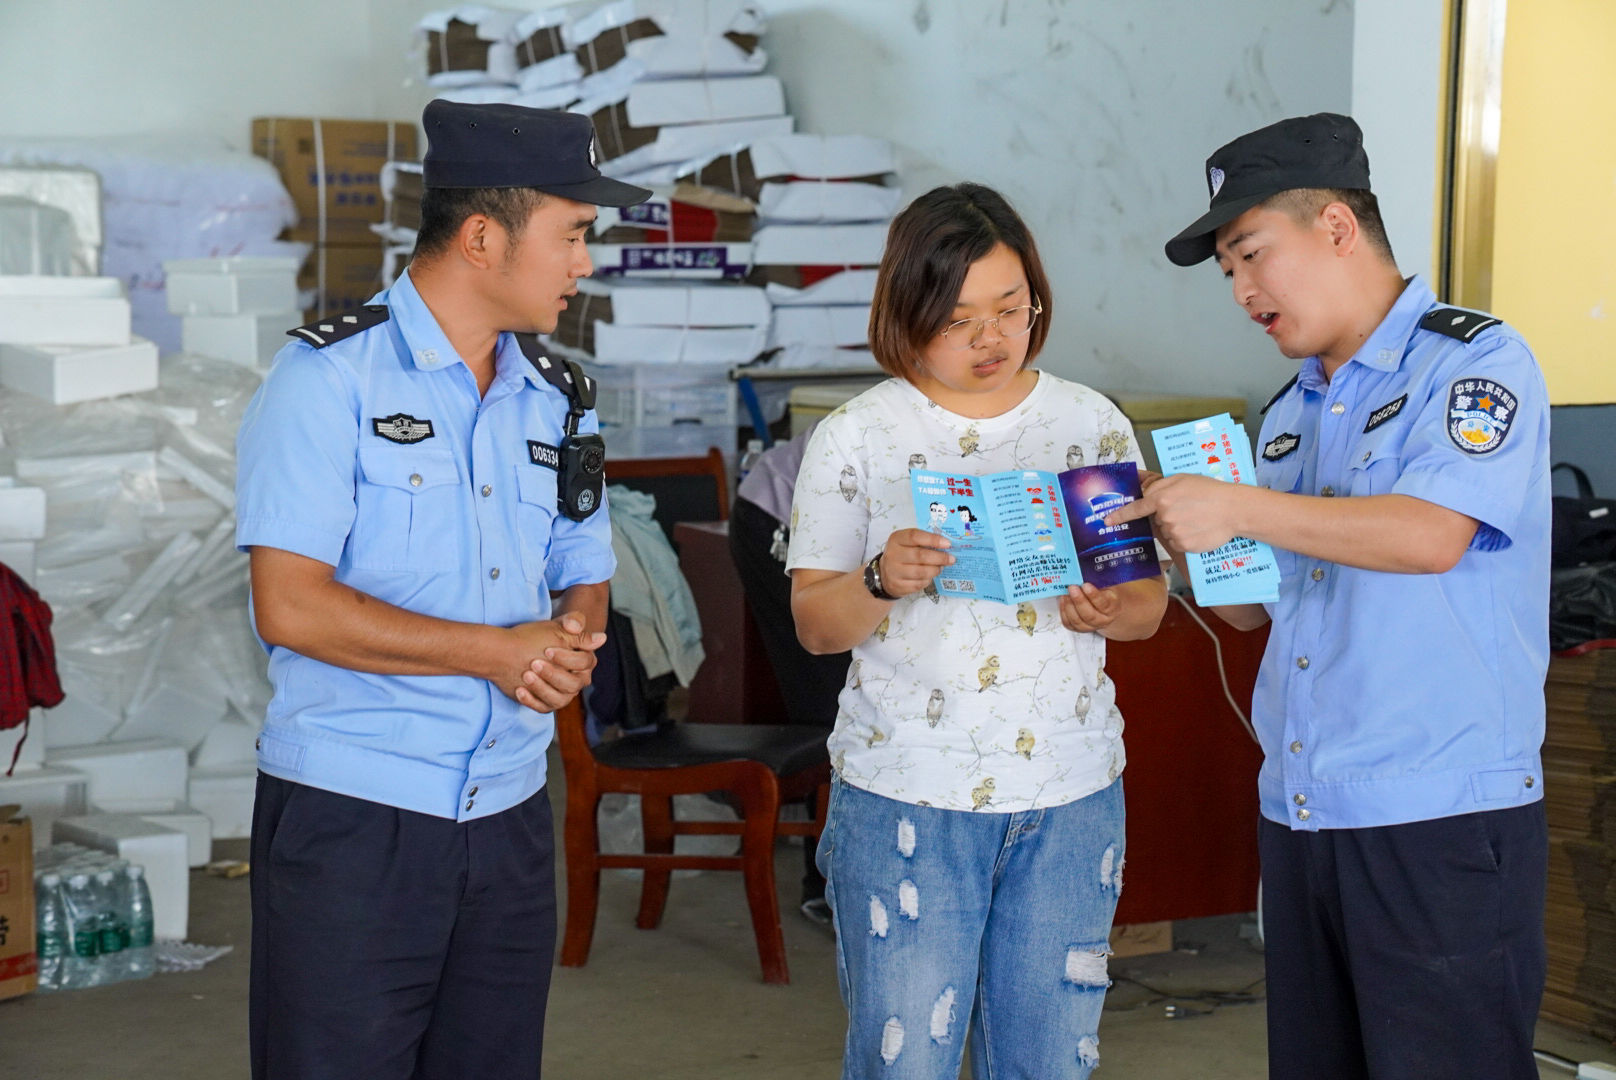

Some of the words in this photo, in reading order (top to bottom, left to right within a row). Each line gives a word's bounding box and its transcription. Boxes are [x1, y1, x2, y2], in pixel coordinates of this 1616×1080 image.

[1454, 381, 1516, 411] 中华人民共和国
[1455, 395, 1473, 410] 警
[1494, 405, 1509, 421] 察
